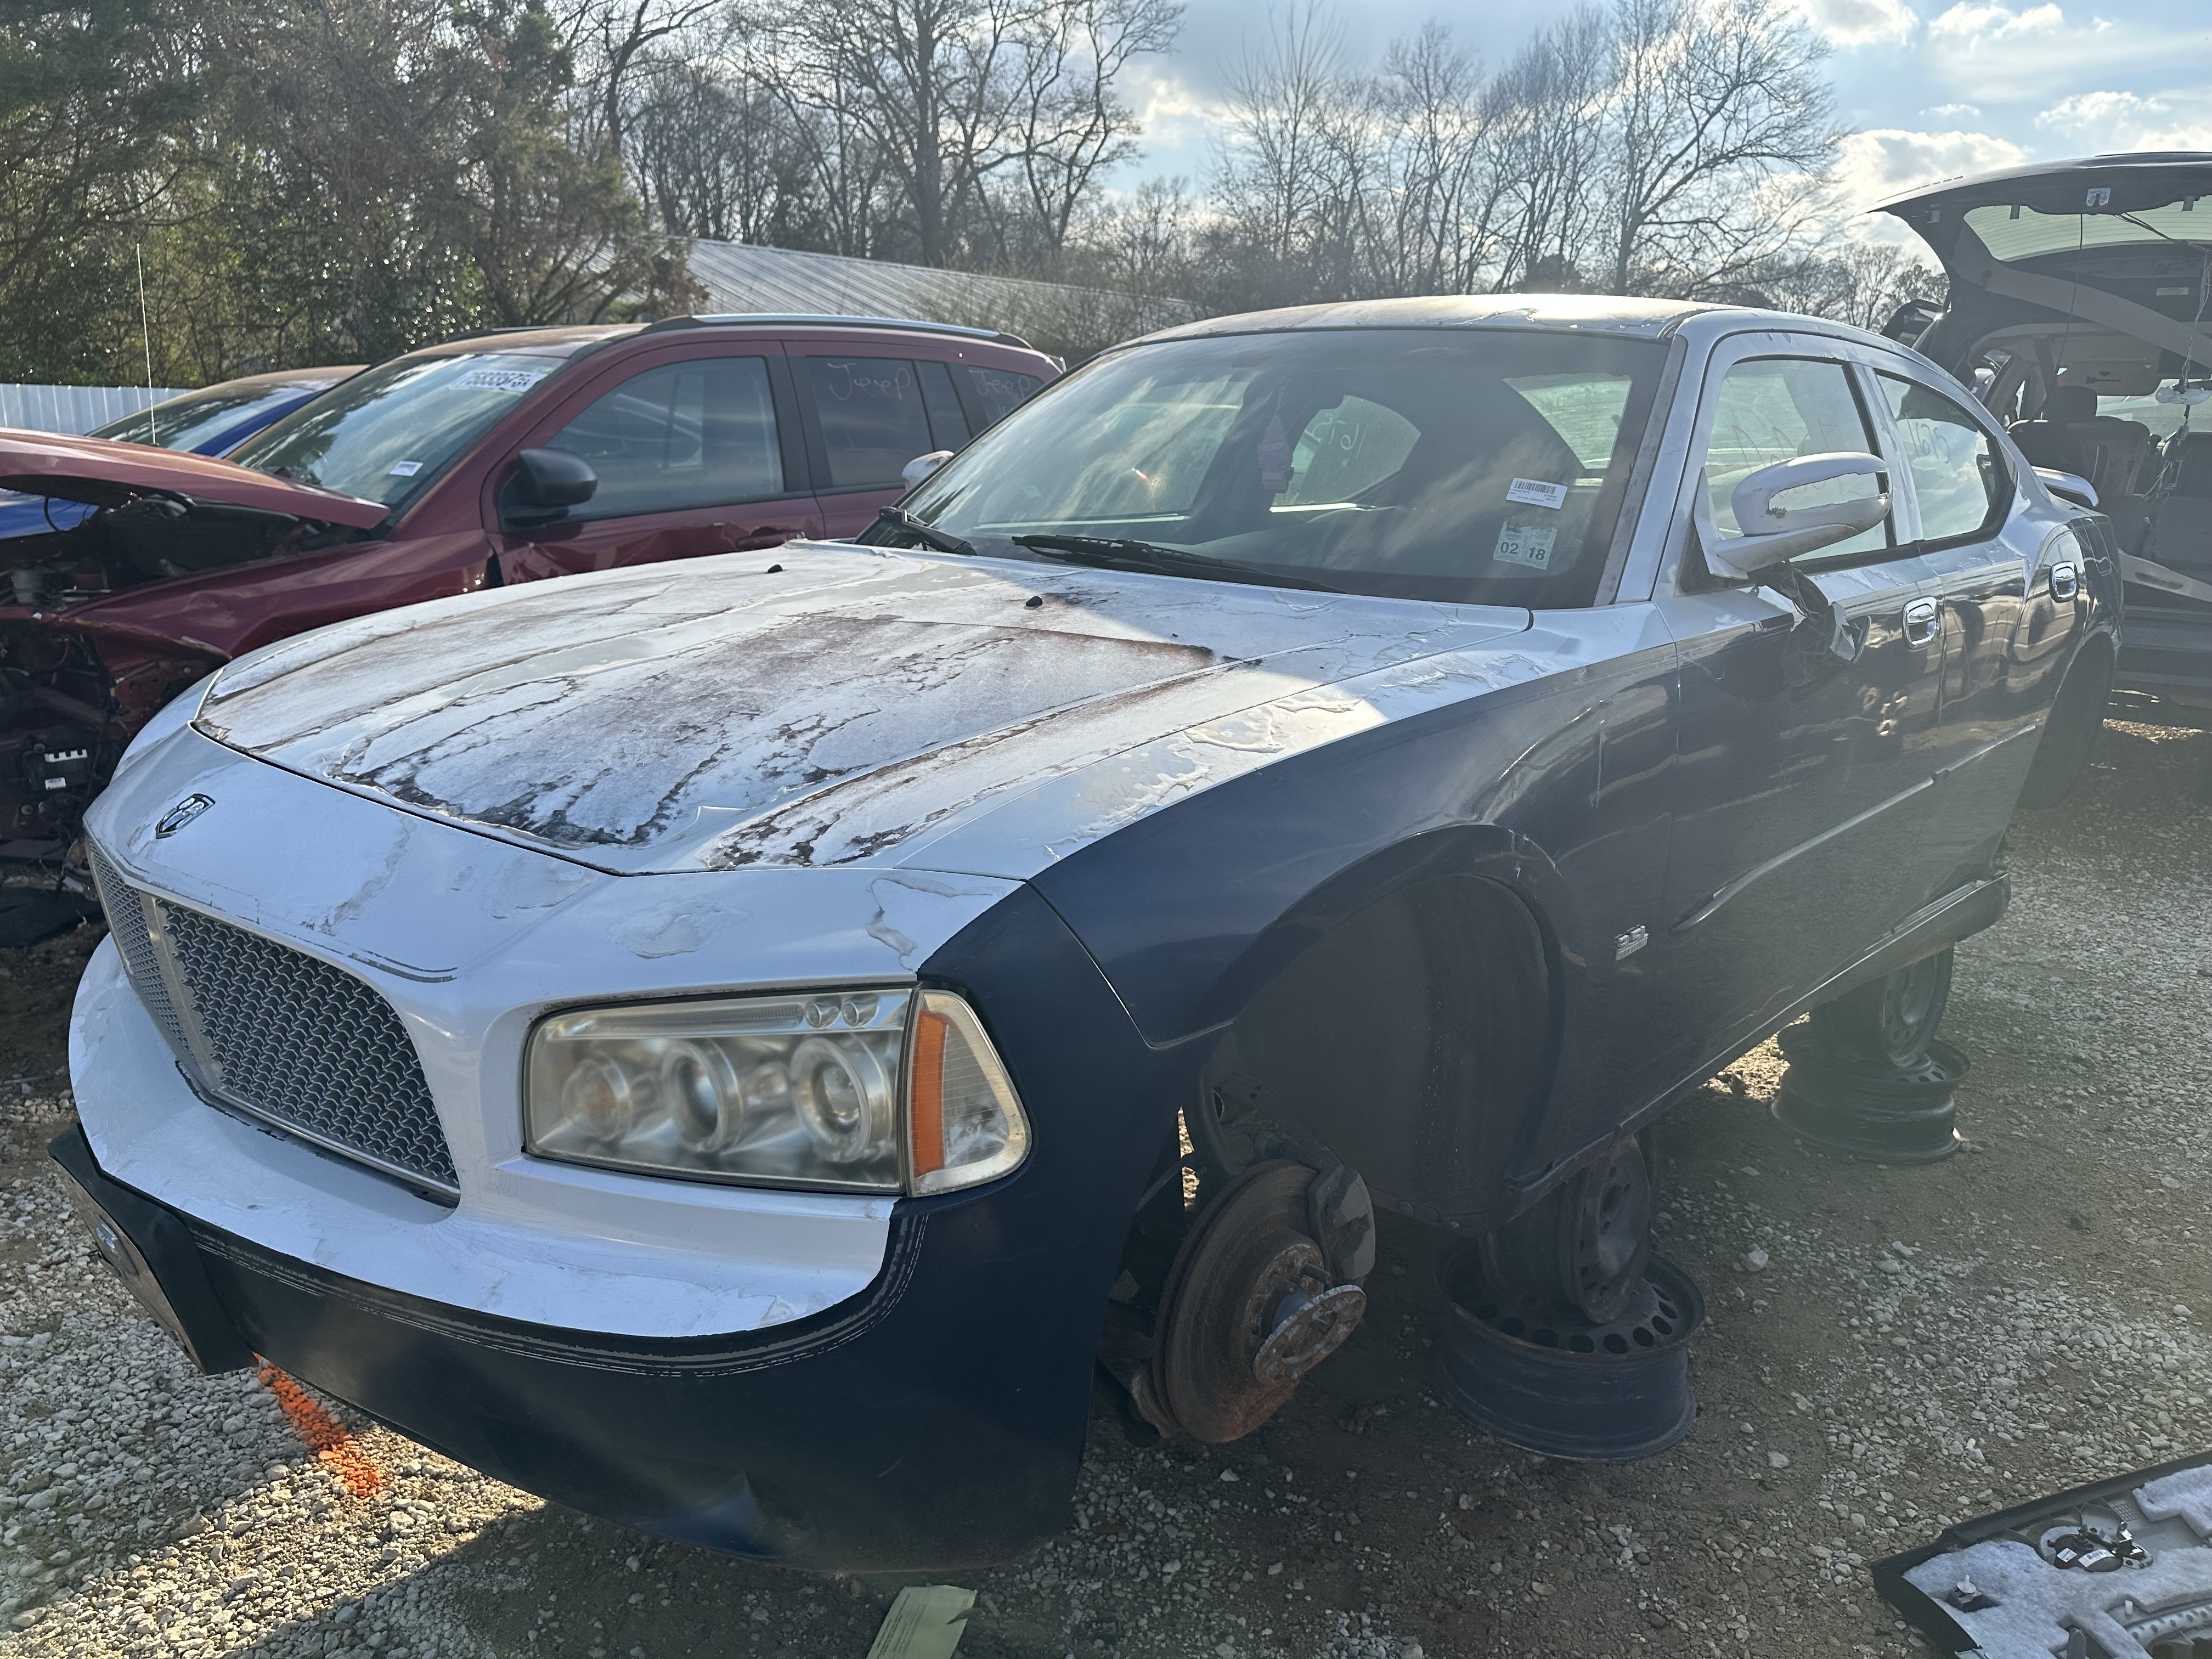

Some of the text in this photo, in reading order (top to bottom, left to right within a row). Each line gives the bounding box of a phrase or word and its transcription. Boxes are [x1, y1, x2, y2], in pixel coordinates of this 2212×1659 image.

[827, 362, 911, 400] Jeep
[969, 369, 1031, 400] Jeep
[1904, 411, 1950, 464] 1675
[1500, 541, 1546, 560] 02 18
